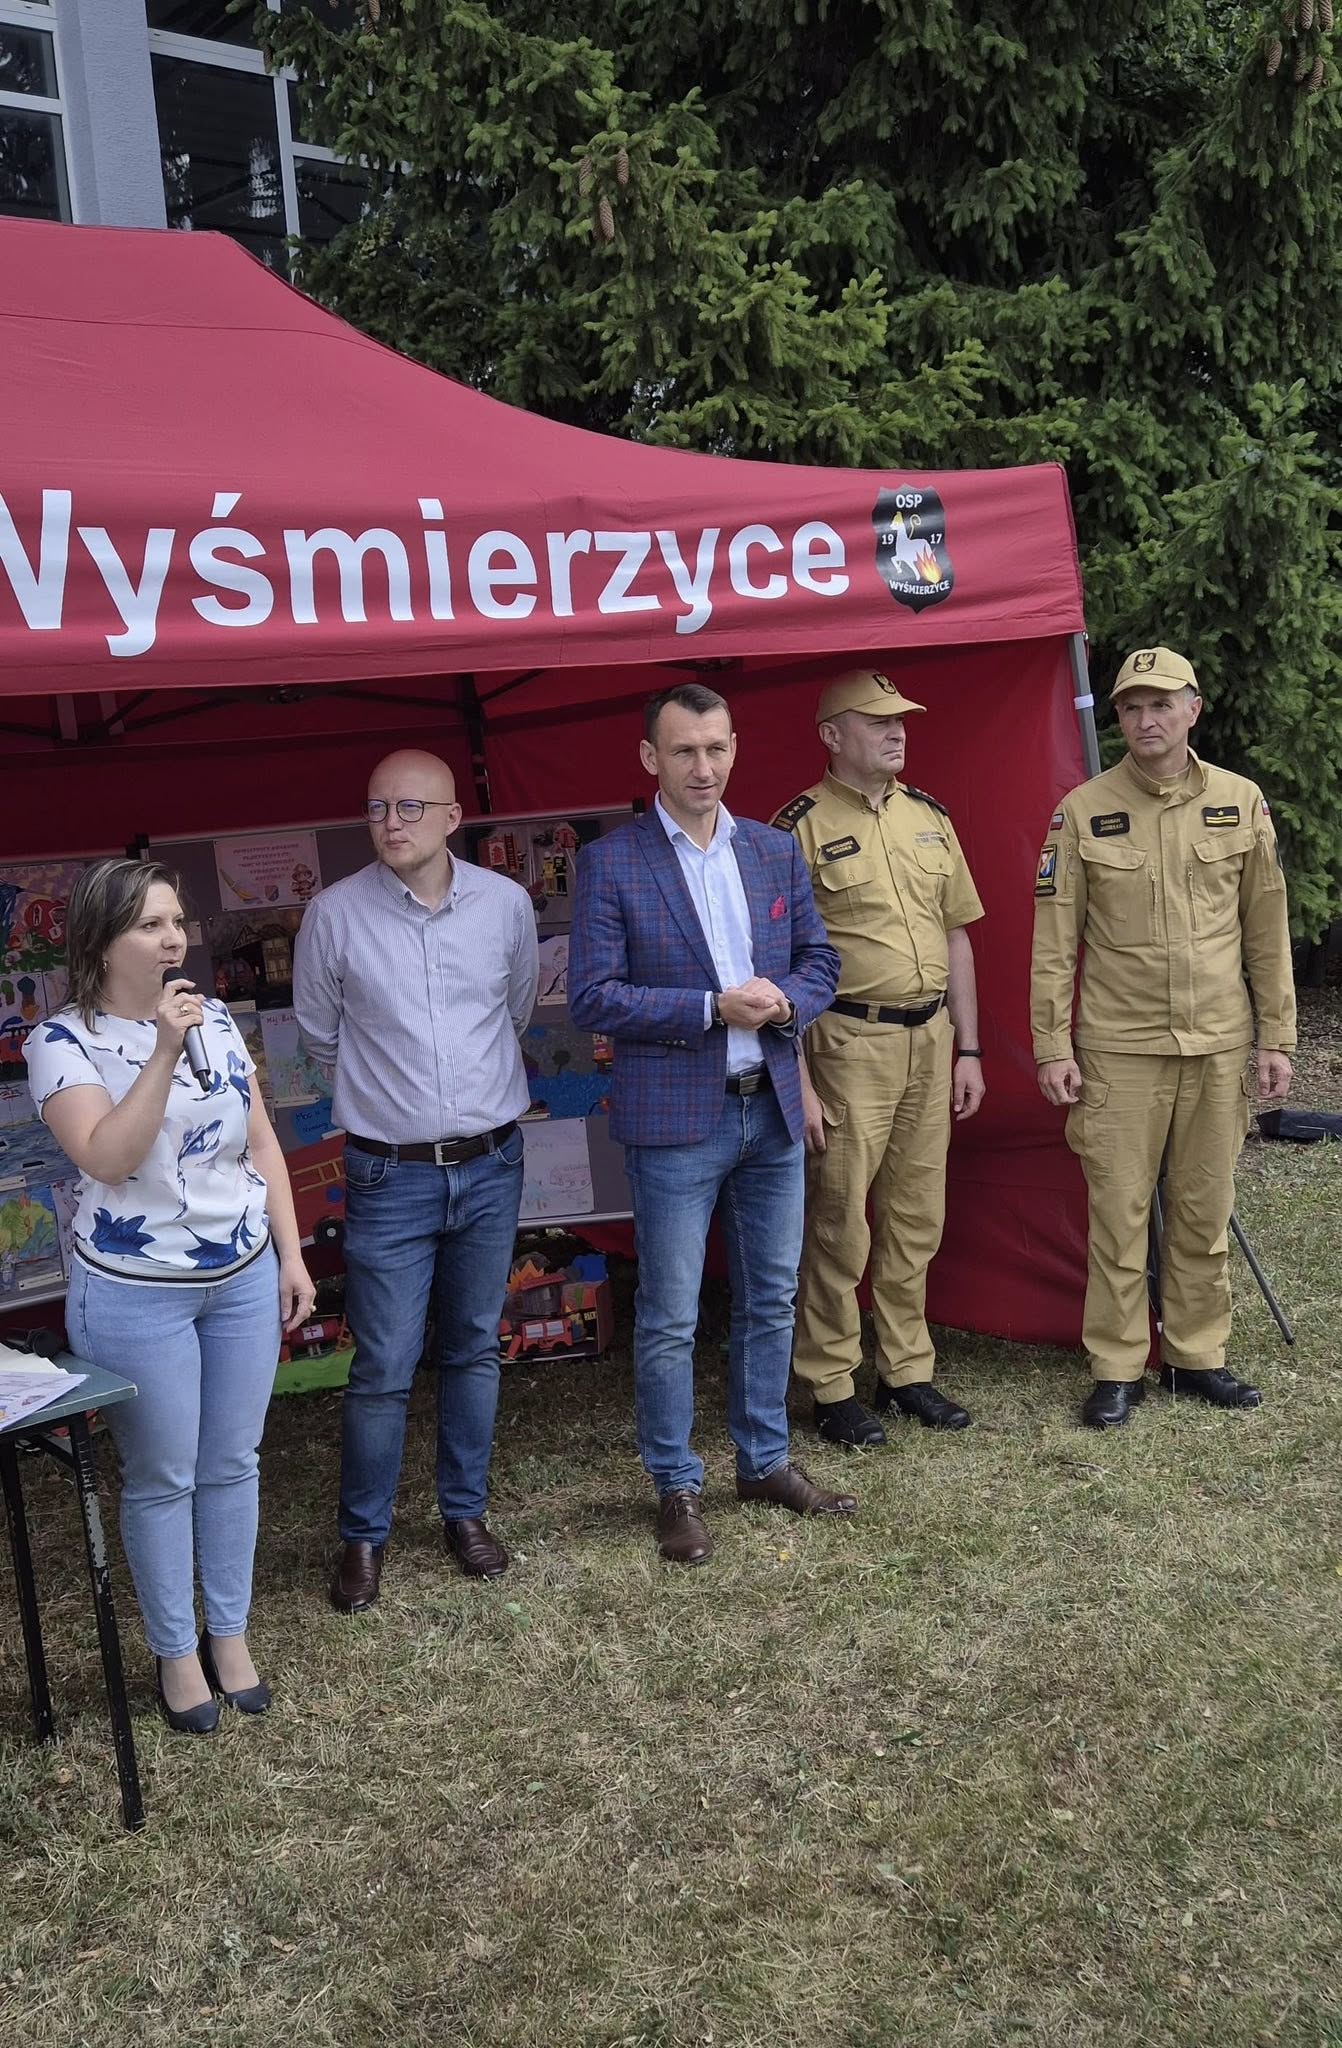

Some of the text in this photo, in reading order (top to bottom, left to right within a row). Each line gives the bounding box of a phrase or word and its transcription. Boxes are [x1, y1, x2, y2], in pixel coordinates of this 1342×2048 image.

[895, 494, 923, 508] OSP
[881, 534, 895, 545] 19
[930, 533, 943, 544] 17
[889, 580, 951, 595] WYŚMIERZYCE
